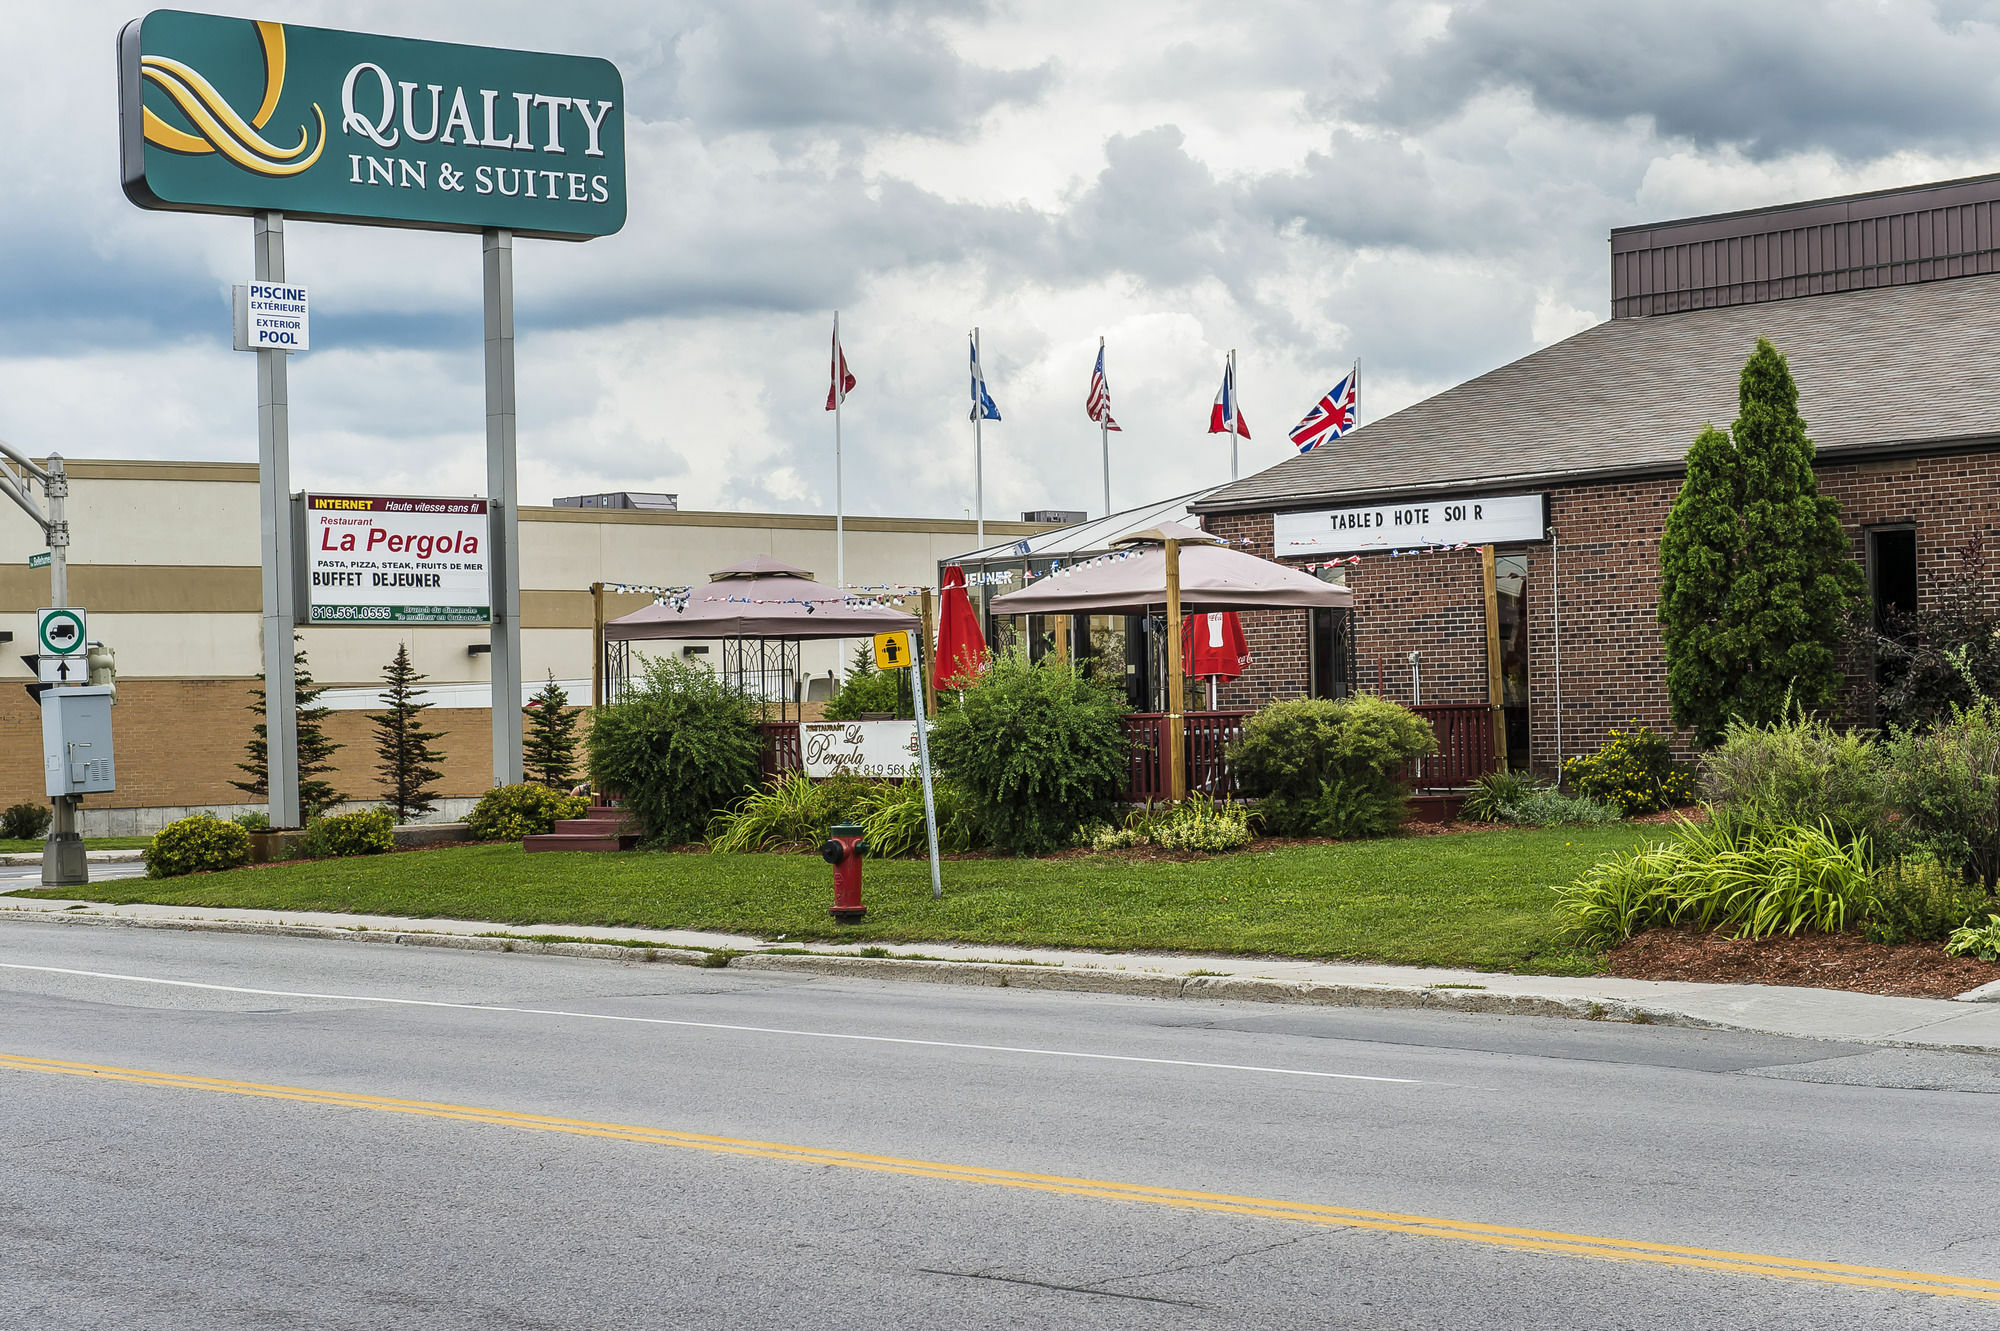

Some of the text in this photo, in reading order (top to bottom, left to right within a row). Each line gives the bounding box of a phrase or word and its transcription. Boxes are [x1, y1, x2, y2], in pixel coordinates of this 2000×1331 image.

[341, 62, 613, 156] QUALITY
[349, 154, 609, 202] INN & SUITES
[250, 285, 306, 302] PISCINE
[251, 300, 306, 313] EXTÉRIEURE
[256, 318, 301, 330] EXTERIOR
[259, 330, 298, 345] POOL
[315, 498, 479, 513] INTERNET Haute vitesse sans fil
[320, 516, 373, 526] Restaurant
[1394, 508, 1430, 526] HOTE
[321, 527, 479, 560] La Pergola
[317, 560, 348, 569] PASTA,
[350, 561, 380, 570] PIZZA,
[381, 562, 414, 570] STEAK,
[416, 562, 448, 570] FRUITS
[312, 571, 441, 588] BUFFET DEJEUNER
[312, 606, 391, 619] 819.561.0555
[843, 724, 865, 745] La
[806, 733, 865, 774] Pergola
[863, 764, 884, 776] 819
[886, 764, 905, 776] 561
